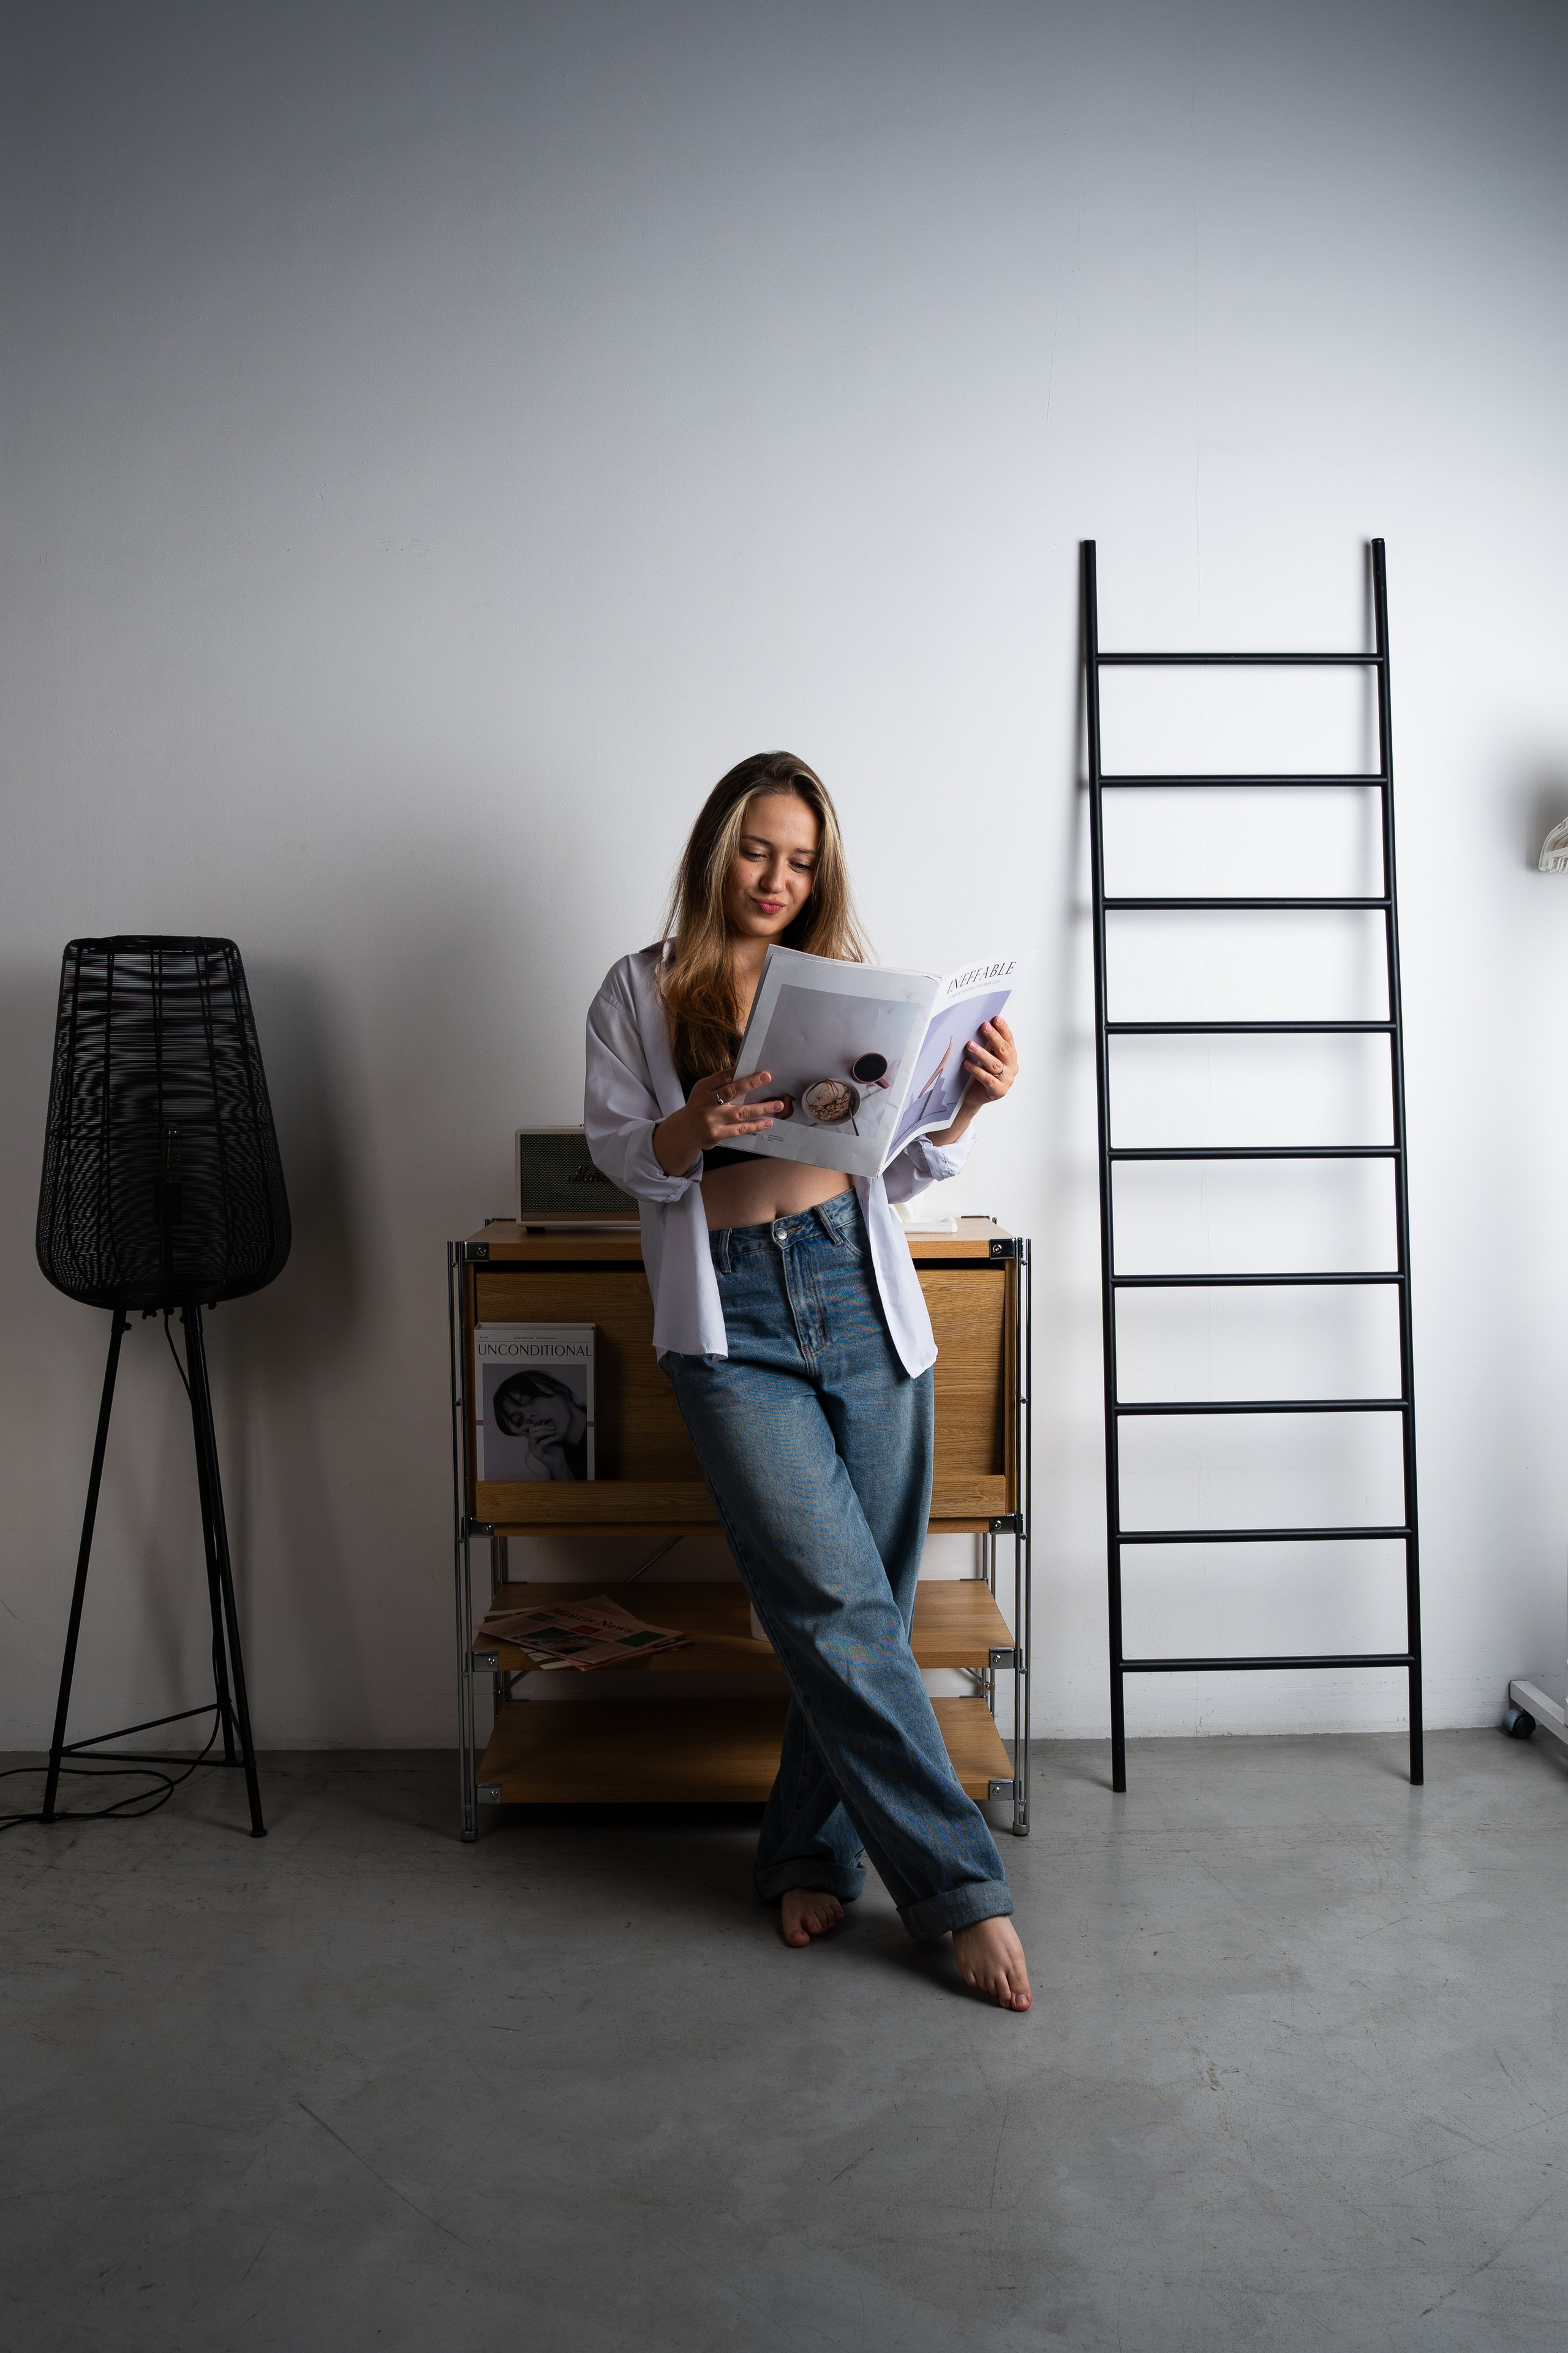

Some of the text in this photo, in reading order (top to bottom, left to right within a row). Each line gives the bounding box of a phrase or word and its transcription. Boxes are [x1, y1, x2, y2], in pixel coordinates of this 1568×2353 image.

[947, 961, 1017, 994] INEFFABLE
[478, 1344, 592, 1356] UNCONDITIONAL
[548, 1607, 597, 1623] Mauris
[597, 1620, 635, 1633] News
